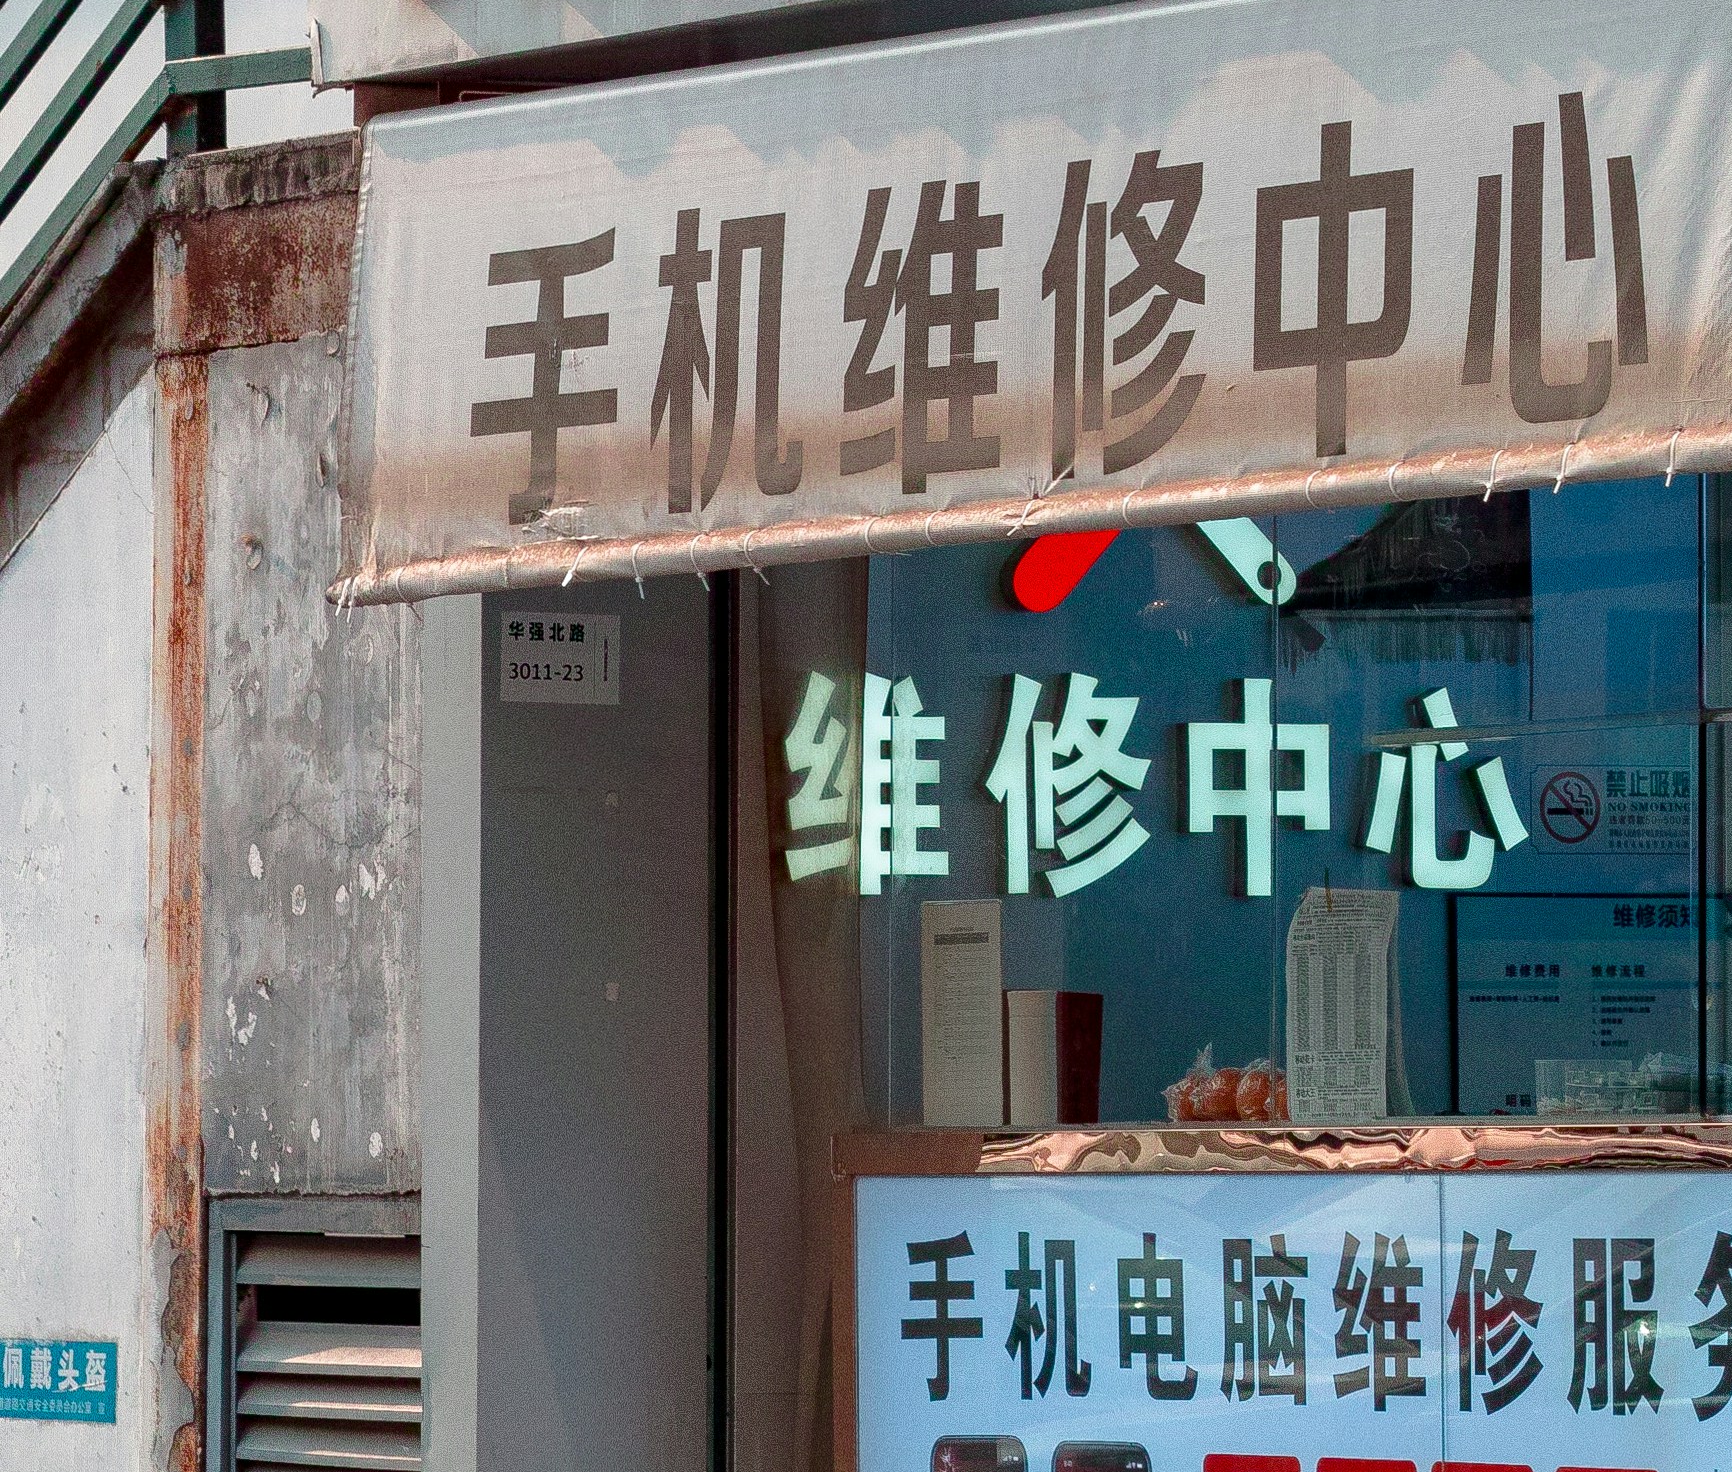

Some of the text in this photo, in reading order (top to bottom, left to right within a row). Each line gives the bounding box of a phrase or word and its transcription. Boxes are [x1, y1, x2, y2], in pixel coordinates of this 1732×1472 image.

[470, 90, 1648, 513] 手机维修中心
[508, 620, 586, 644] 华强北路
[508, 662, 585, 682] 3011-23
[784, 672, 1528, 897] 维修中心
[1607, 802, 1626, 812] NO
[3, 1347, 107, 1392] 佩戴头盔
